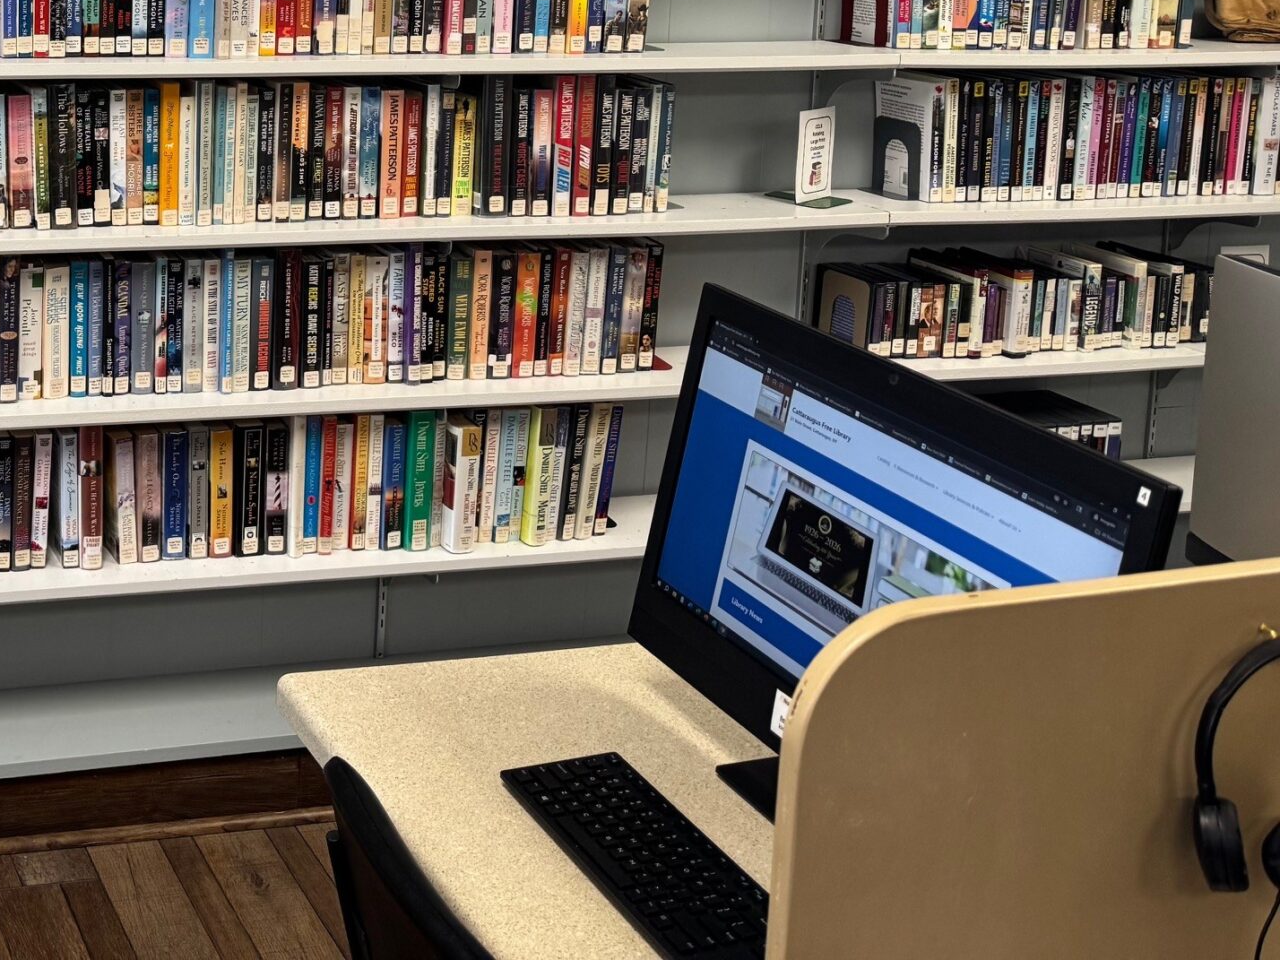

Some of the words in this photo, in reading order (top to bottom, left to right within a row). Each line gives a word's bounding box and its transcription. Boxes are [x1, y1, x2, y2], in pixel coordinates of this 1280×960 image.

[58, 93, 67, 112] The
[389, 95, 400, 127] JAMES
[58, 113, 68, 154] Hollows
[387, 129, 399, 181] PATTERSON
[478, 274, 488, 293] NORA
[1174, 275, 1182, 293] WILD
[22, 298, 32, 337] Picoult
[1172, 296, 1181, 327] ANIMUS
[821, 420, 833, 433] Free
[832, 427, 852, 442] Library
[804, 524, 820, 539] 1926
[824, 538, 842, 552] 2026
[731, 597, 749, 614] Library
[749, 609, 763, 623] News
